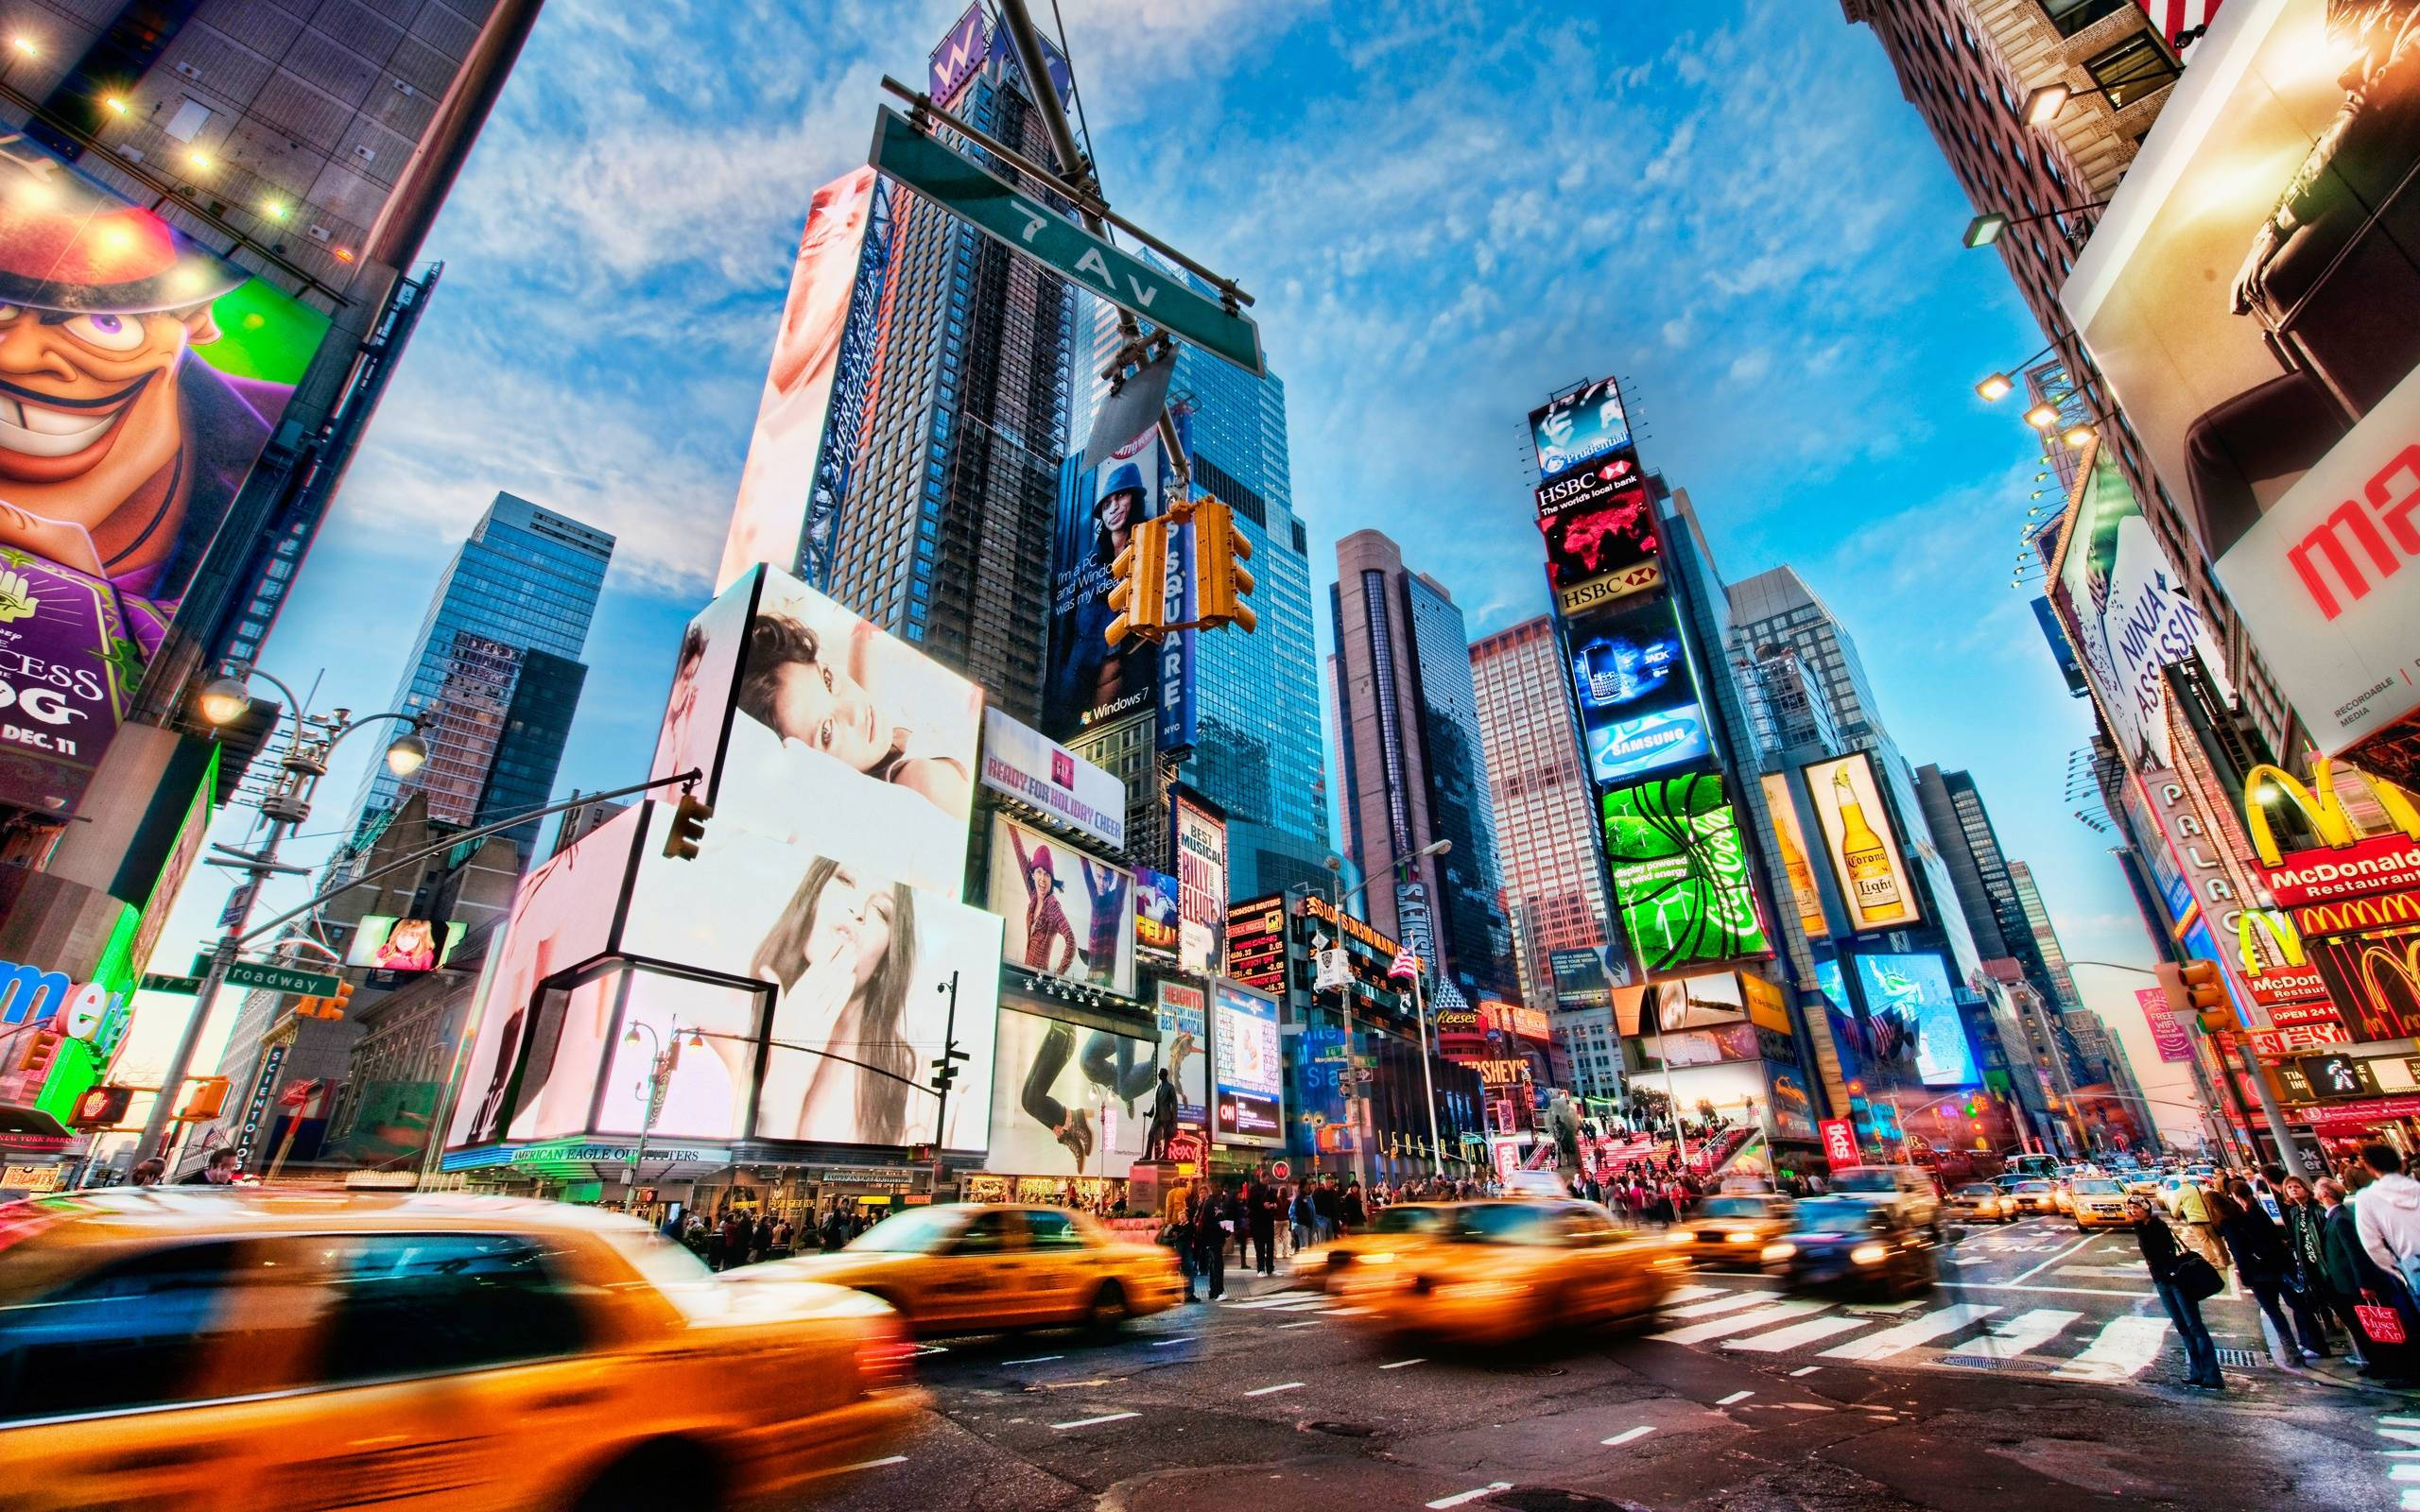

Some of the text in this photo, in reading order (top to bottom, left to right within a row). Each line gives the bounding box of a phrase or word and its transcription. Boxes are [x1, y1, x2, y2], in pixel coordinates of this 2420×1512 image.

[1011, 199, 1047, 242] 7
[829, 269, 877, 485] AMERICAN EAGLE
[846, 319, 877, 466] OUTFITTERS
[1565, 432, 1629, 465] Prudential
[1538, 472, 1598, 507] HSBC
[1542, 474, 1637, 517] The world's local bank
[1056, 563, 1113, 601] and Windo
[1058, 554, 1098, 585] I'm a PC
[1055, 598, 1075, 616] was
[1078, 588, 1095, 604] my
[1563, 576, 1623, 610] HSBC
[1163, 551, 1184, 710] SQUARE
[2118, 581, 2168, 671] NINJA
[1093, 687, 1150, 721] Windows 7
[2334, 677, 2394, 718] RECORDABLE
[1164, 722, 1181, 734] NYC
[2340, 707, 2371, 728] MEDIA
[2, 724, 77, 756] DEC. 11
[1612, 728, 1685, 757] SAMSUNG
[1055, 761, 1070, 780] GAP
[988, 756, 1121, 840] READY FOR HOLIDAY CHEER
[1190, 823, 1214, 847] BEST
[1182, 833, 1222, 867] MUSICAL
[1848, 852, 1885, 868] Corona
[1182, 850, 1209, 895] BILLY
[1615, 855, 1687, 878] display powered
[1618, 868, 1687, 887] by wind energy
[2273, 847, 2420, 889] McDonald
[1858, 879, 1893, 896] Light
[1229, 897, 1282, 918] THOMSON REUTERS
[1228, 925, 1245, 937] STOCK
[162, 977, 172, 989] 7
[233, 969, 319, 993] roadway
[2253, 974, 2323, 993] McDon
[2273, 986, 2326, 999] Restaur
[1164, 985, 1203, 1011] HEIGHTS
[1161, 1014, 1176, 1031] BEST
[1436, 1007, 1477, 1025] Reese's
[2150, 1011, 2175, 1022] FREE
[2273, 1009, 2308, 1022] OPEN
[2310, 1006, 2327, 1017] 24
[1460, 1058, 1530, 1084] RSHEY'S
[1219, 1103, 1236, 1122] CNN
[1377, 1128, 1426, 1159] 1585
[1828, 1123, 1851, 1160] tkts
[513, 1148, 565, 1162] AMERICAN
[566, 1148, 611, 1160] EAGLE
[1273, 1164, 1287, 1176] W
[2370, 1307, 2394, 1320] Met
[2371, 1328, 2382, 1340] of
